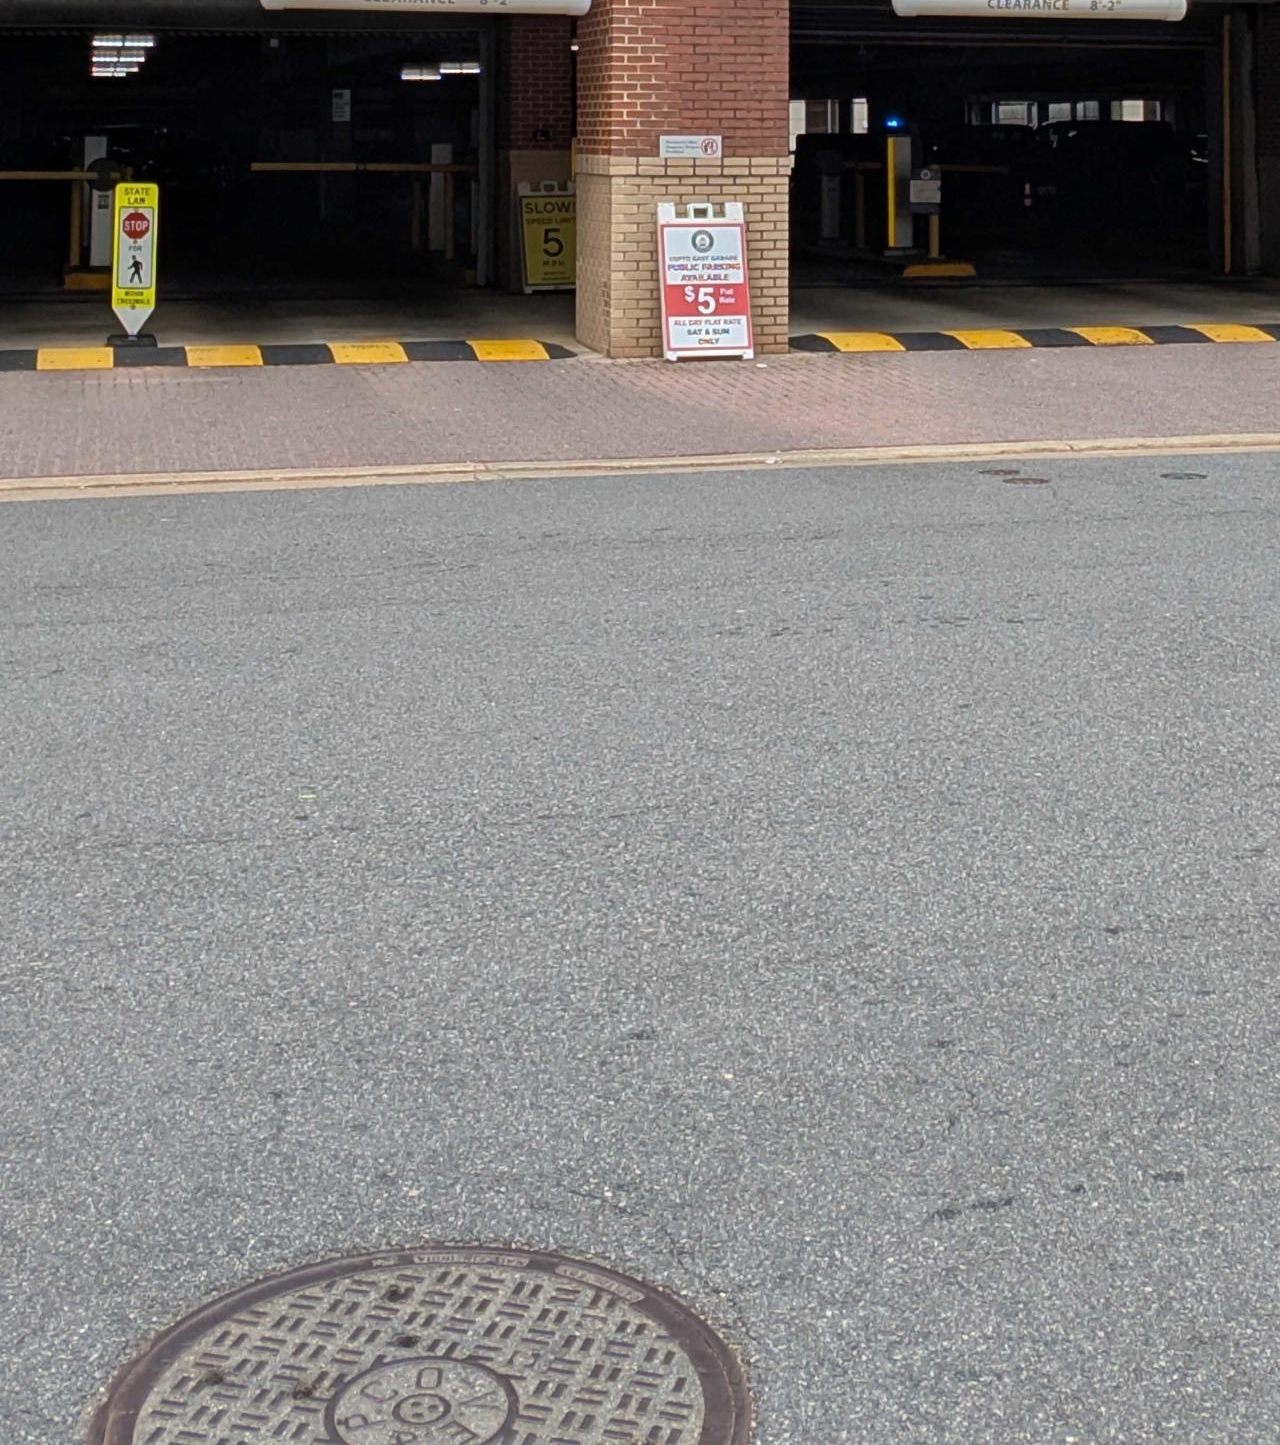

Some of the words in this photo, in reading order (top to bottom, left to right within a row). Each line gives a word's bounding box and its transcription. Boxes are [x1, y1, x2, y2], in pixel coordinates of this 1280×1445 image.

[124, 187, 151, 196] STATE
[127, 197, 146, 205] LAW
[124, 220, 149, 231] STOP
[542, 228, 564, 258] 5
[667, 263, 699, 271] PUBLIC
[702, 262, 740, 271] PARKING
[681, 273, 729, 281] AVAILABLE
[684, 285, 716, 314] $5
